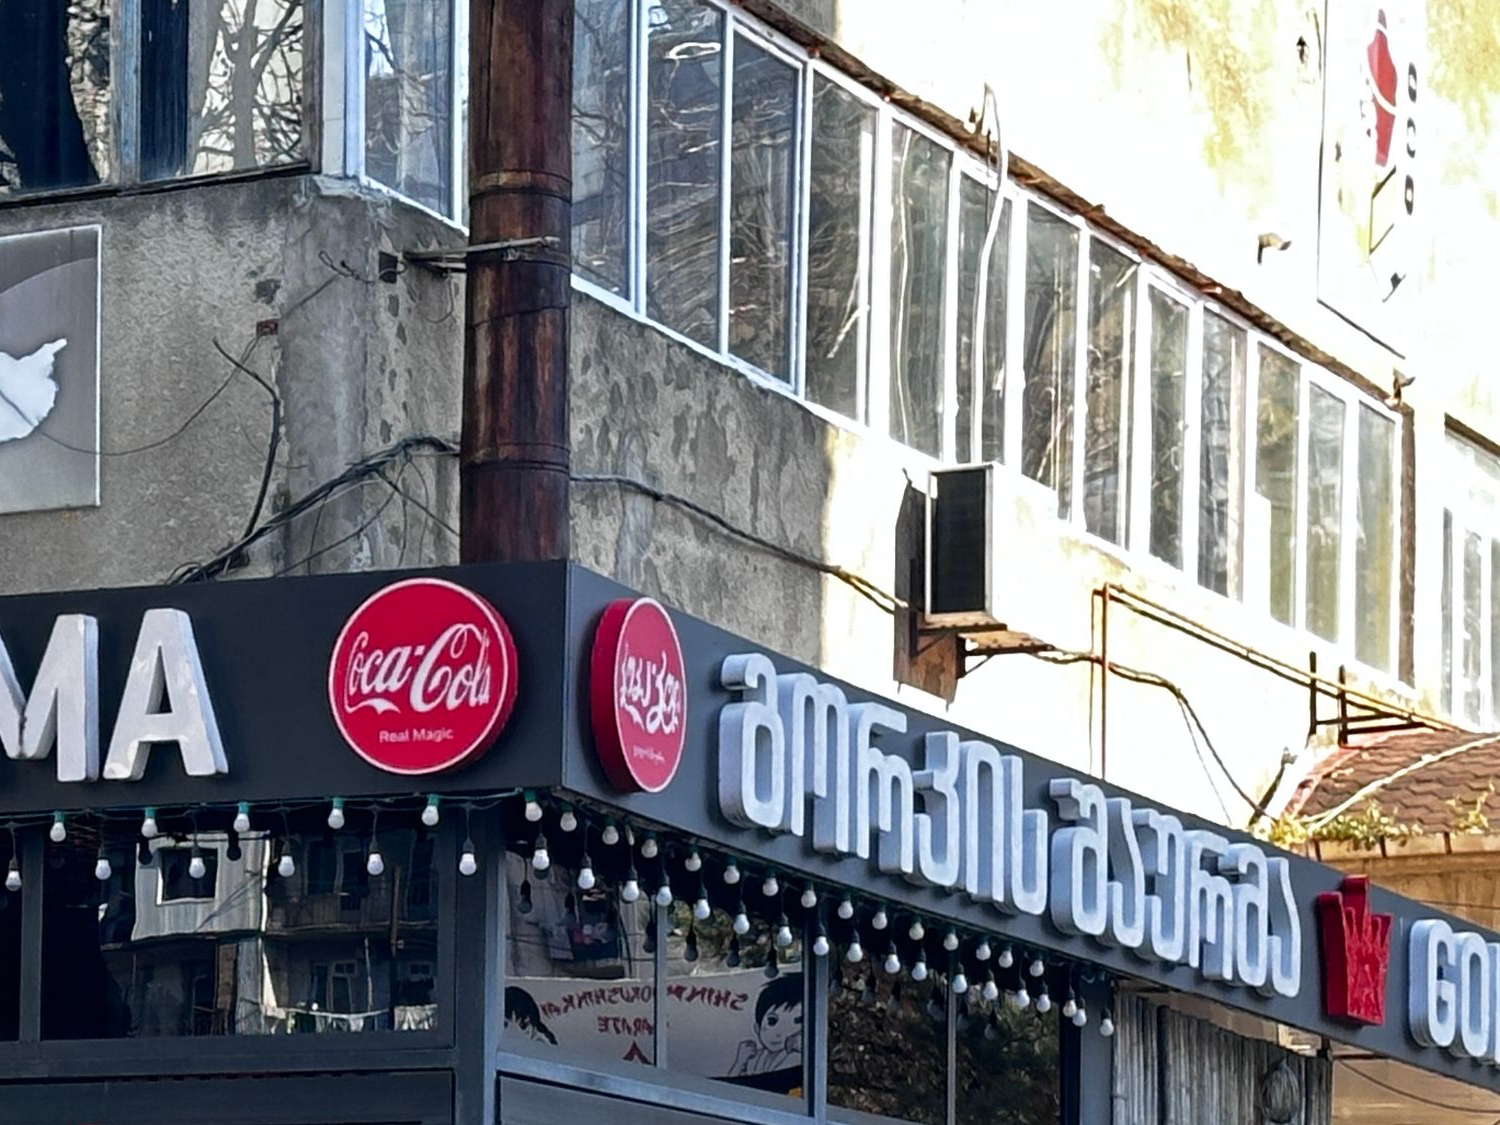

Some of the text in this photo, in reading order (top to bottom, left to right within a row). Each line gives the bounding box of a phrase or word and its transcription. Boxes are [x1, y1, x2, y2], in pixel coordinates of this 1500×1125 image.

[344, 622, 492, 716] Coca-Cola
[378, 726, 455, 743] Real Magic
[718, 653, 1301, 999] გორკის შაურმა
